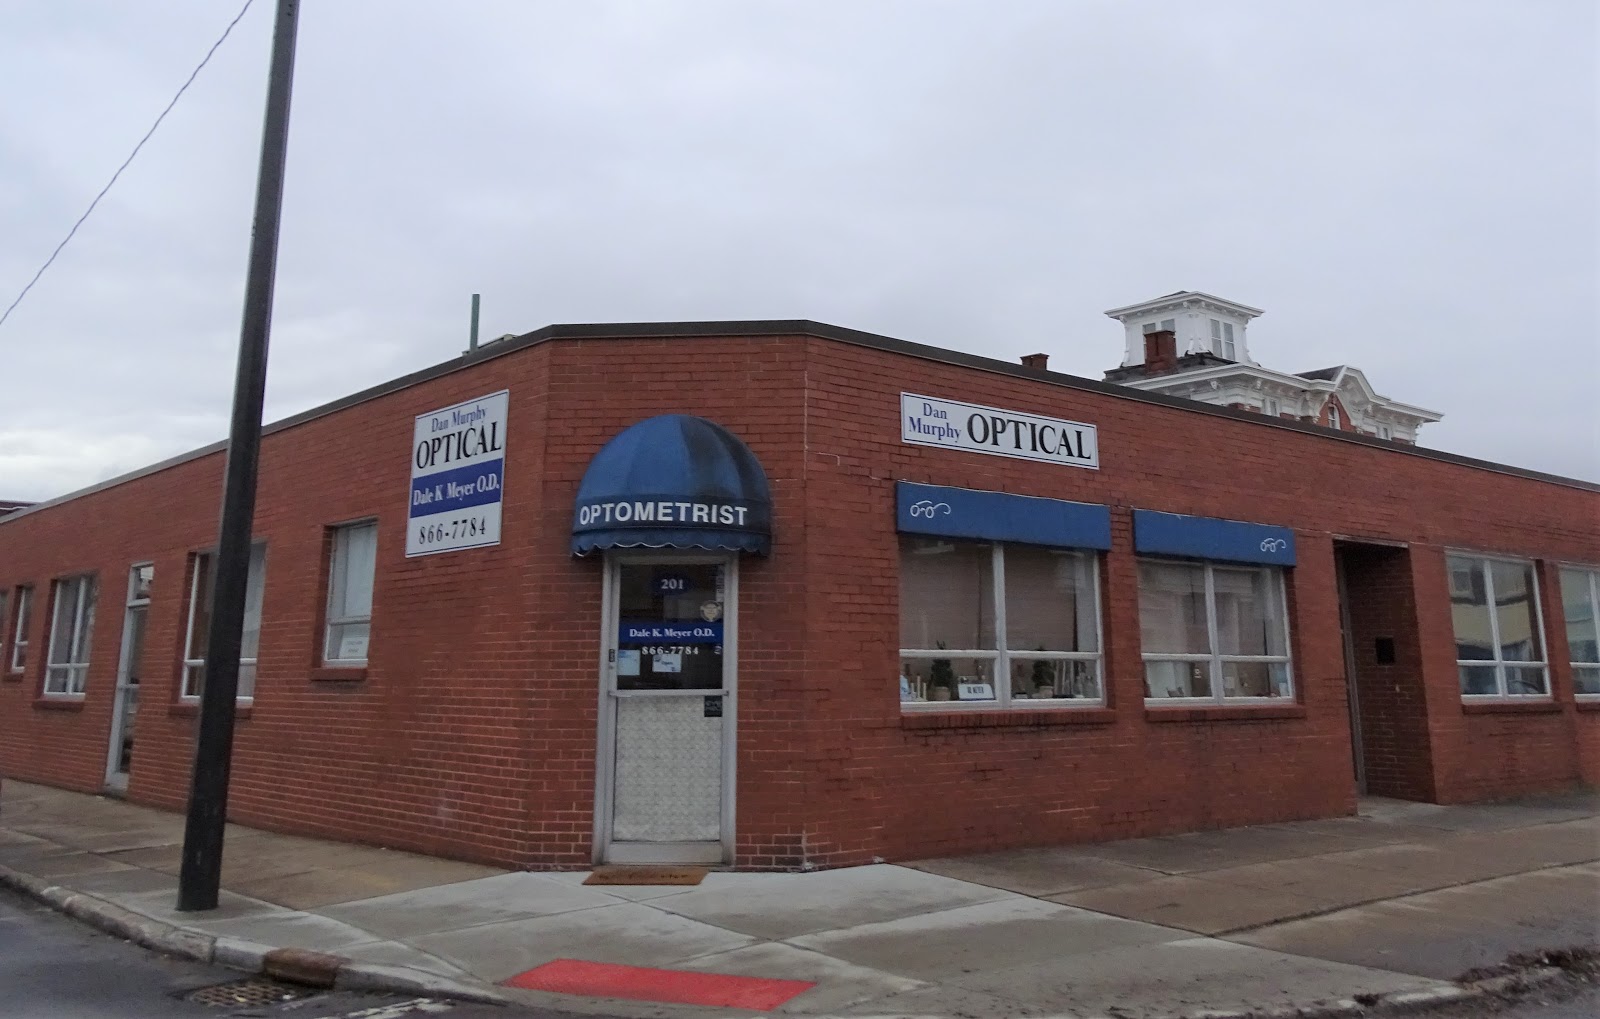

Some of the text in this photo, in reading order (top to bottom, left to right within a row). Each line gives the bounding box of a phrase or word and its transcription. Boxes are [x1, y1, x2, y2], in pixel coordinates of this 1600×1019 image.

[431, 405, 488, 433] Dan Murphy
[923, 402, 947, 419] Dan
[909, 416, 961, 443] Murphy
[967, 413, 1091, 460] OPTICAL
[416, 420, 502, 469] OPTICAL
[413, 488, 434, 506] Dale
[446, 481, 476, 501] Meyer
[476, 473, 500, 493] O.D.
[579, 501, 748, 526] OPTOMETRIST
[418, 516, 486, 545] 866-7784
[661, 579, 684, 590] 201
[629, 628, 715, 639] Dale K. Meyer O.D.
[641, 646, 699, 655] 866-7784
